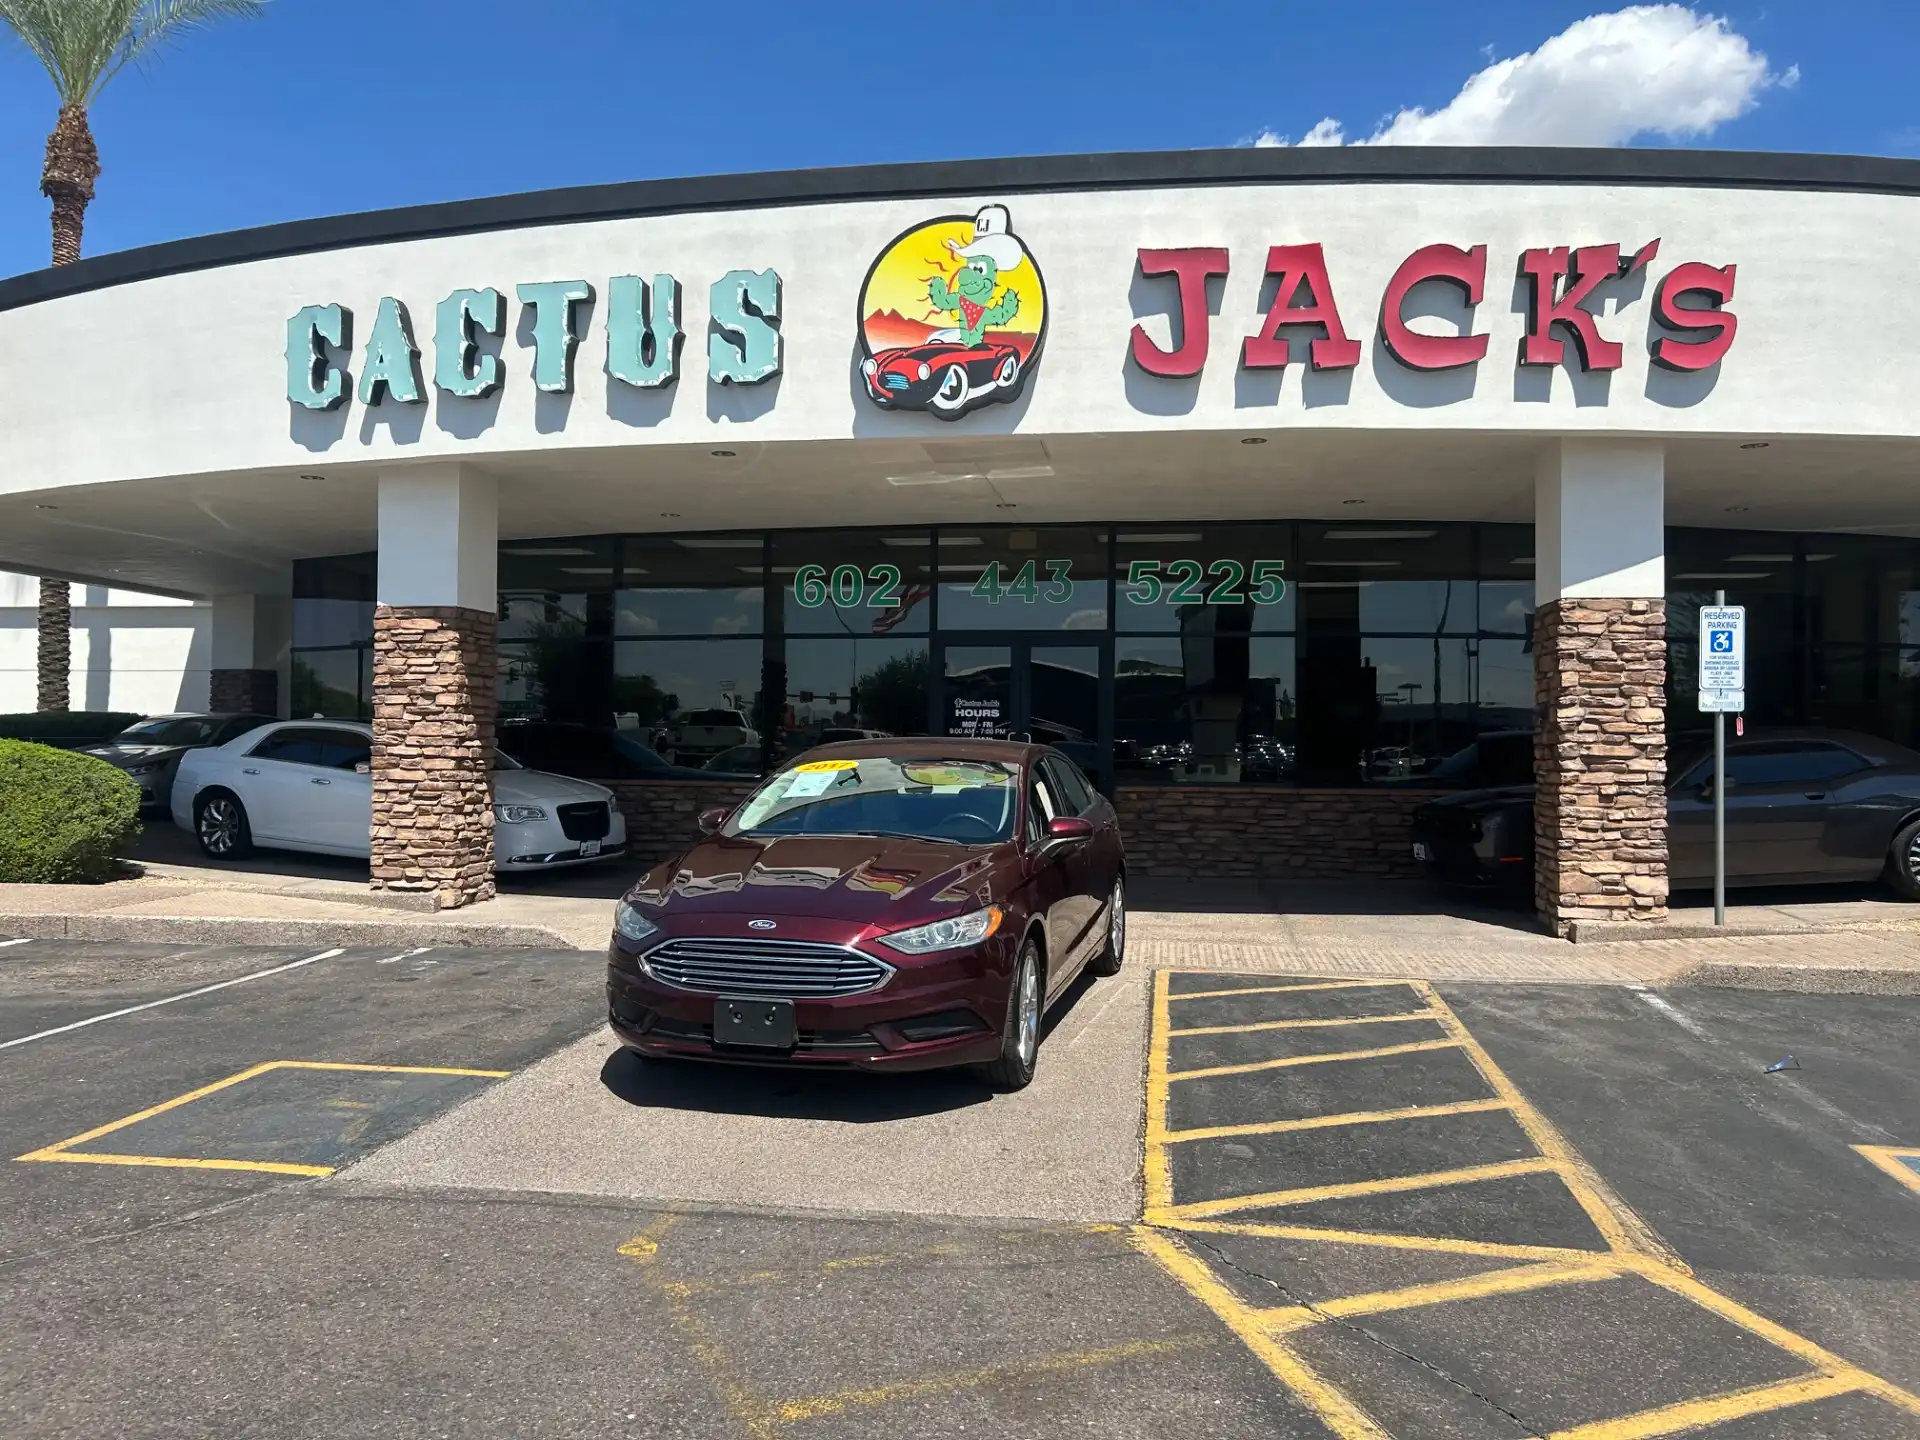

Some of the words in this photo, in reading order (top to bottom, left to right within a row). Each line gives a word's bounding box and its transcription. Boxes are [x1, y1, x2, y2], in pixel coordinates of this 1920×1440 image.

[284, 267, 783, 411] CACTUS
[1131, 238, 1738, 379] JACK'S
[793, 563, 902, 608] 602
[970, 558, 1075, 605] 443
[1126, 558, 1288, 606] 5225
[1704, 611, 1741, 620] RESERVED
[1707, 621, 1738, 629] PARKING
[955, 709, 1000, 718] HOURS
[995, 727, 1006, 735] PM
[803, 761, 853, 771] 2017
